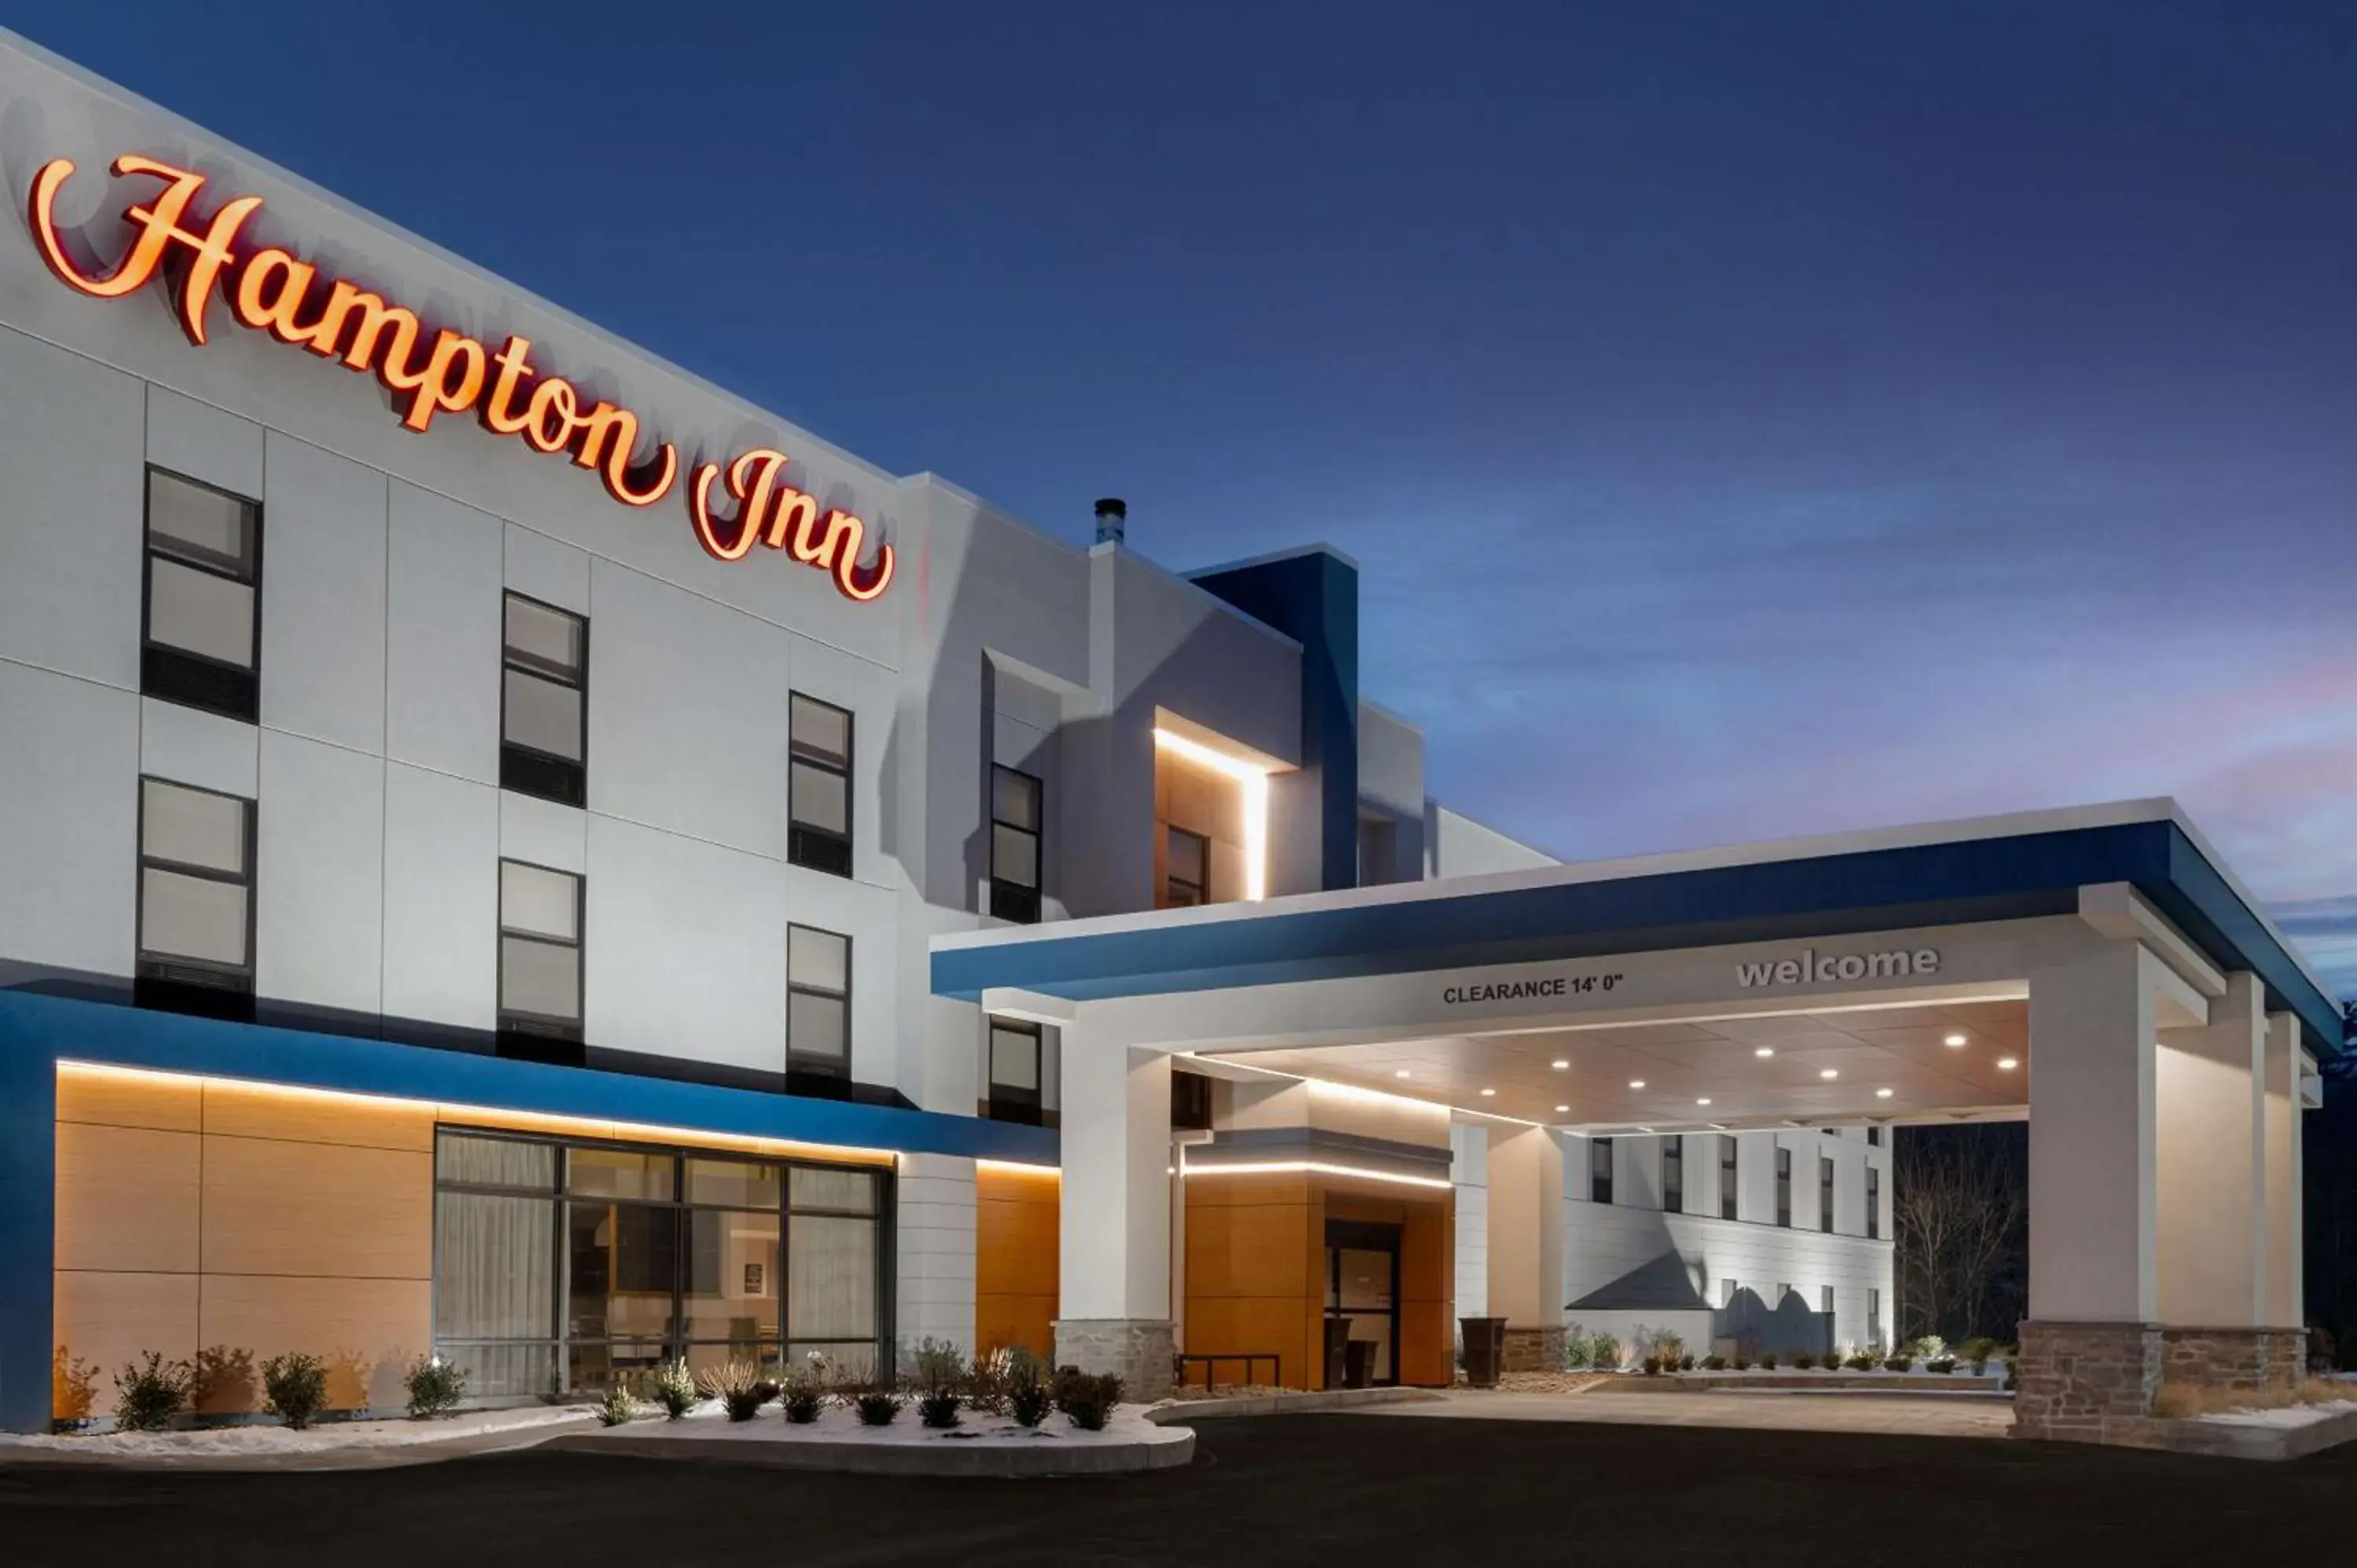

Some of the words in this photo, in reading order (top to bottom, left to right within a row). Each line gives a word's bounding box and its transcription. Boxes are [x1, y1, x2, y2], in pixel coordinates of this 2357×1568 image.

[28, 154, 676, 506] Hampton
[689, 447, 895, 601] Inn
[1735, 947, 1941, 987] welcome
[1443, 978, 1565, 1004] CLEARANCE
[1571, 976, 1598, 994] 14'
[1603, 973, 1624, 991] 0"
